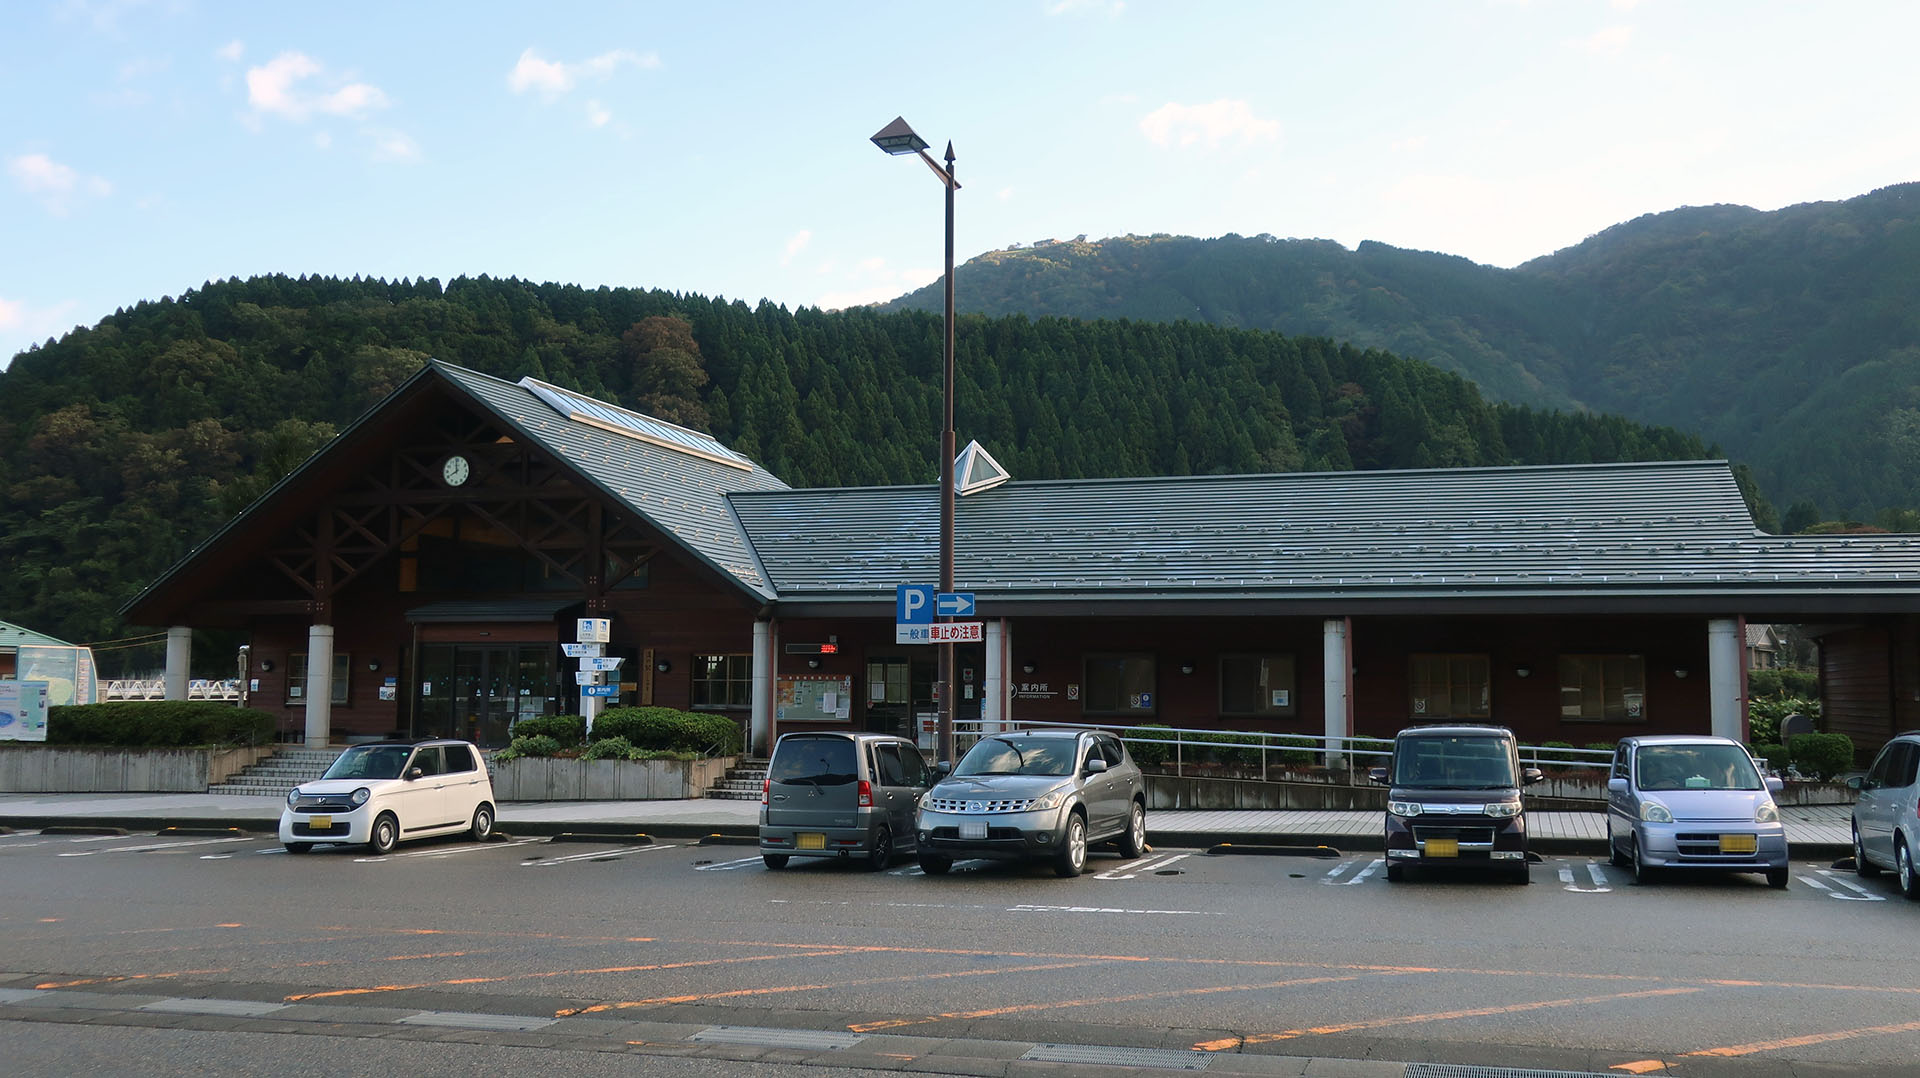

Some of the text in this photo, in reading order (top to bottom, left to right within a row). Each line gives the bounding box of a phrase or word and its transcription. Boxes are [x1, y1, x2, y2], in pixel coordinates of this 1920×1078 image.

[904, 589, 926, 620] P
[930, 625, 980, 640] 車止め注意
[1021, 683, 1049, 692] 案内所
